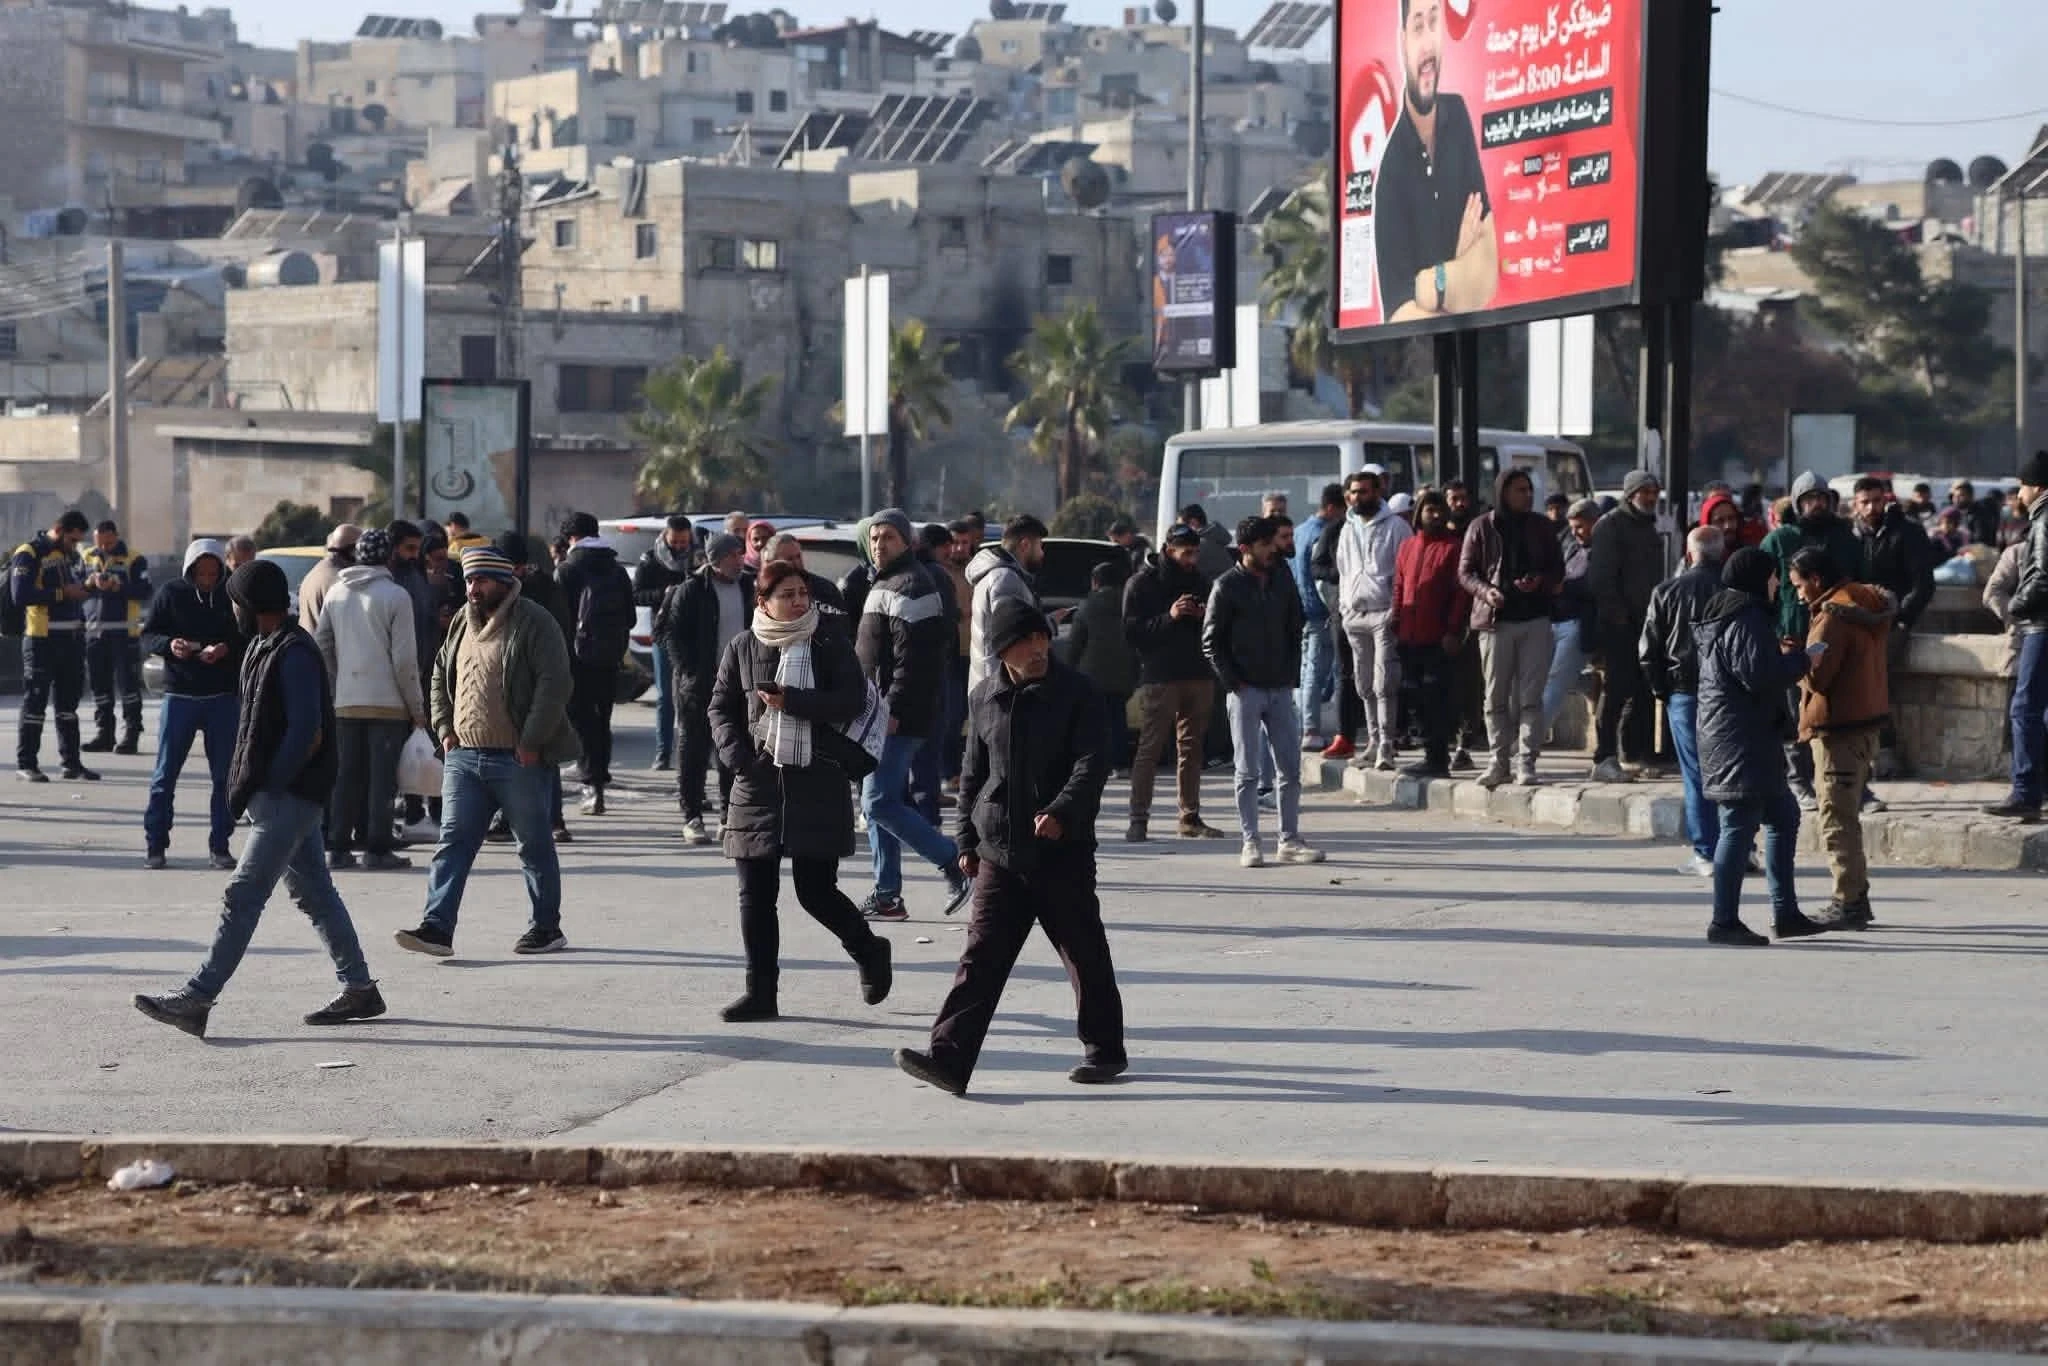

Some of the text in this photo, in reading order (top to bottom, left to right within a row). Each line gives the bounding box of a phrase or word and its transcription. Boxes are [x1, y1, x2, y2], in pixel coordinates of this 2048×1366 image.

[1486, 21, 1519, 53] جمعة
[1520, 23, 1540, 58] يوم
[1540, 3, 1560, 47] كل
[1527, 63, 1561, 93] 8:00
[1562, 41, 1610, 84] الساعة
[1569, 98, 1593, 120] منصة
[1592, 92, 1609, 123] على
[1512, 109, 1529, 138] على
